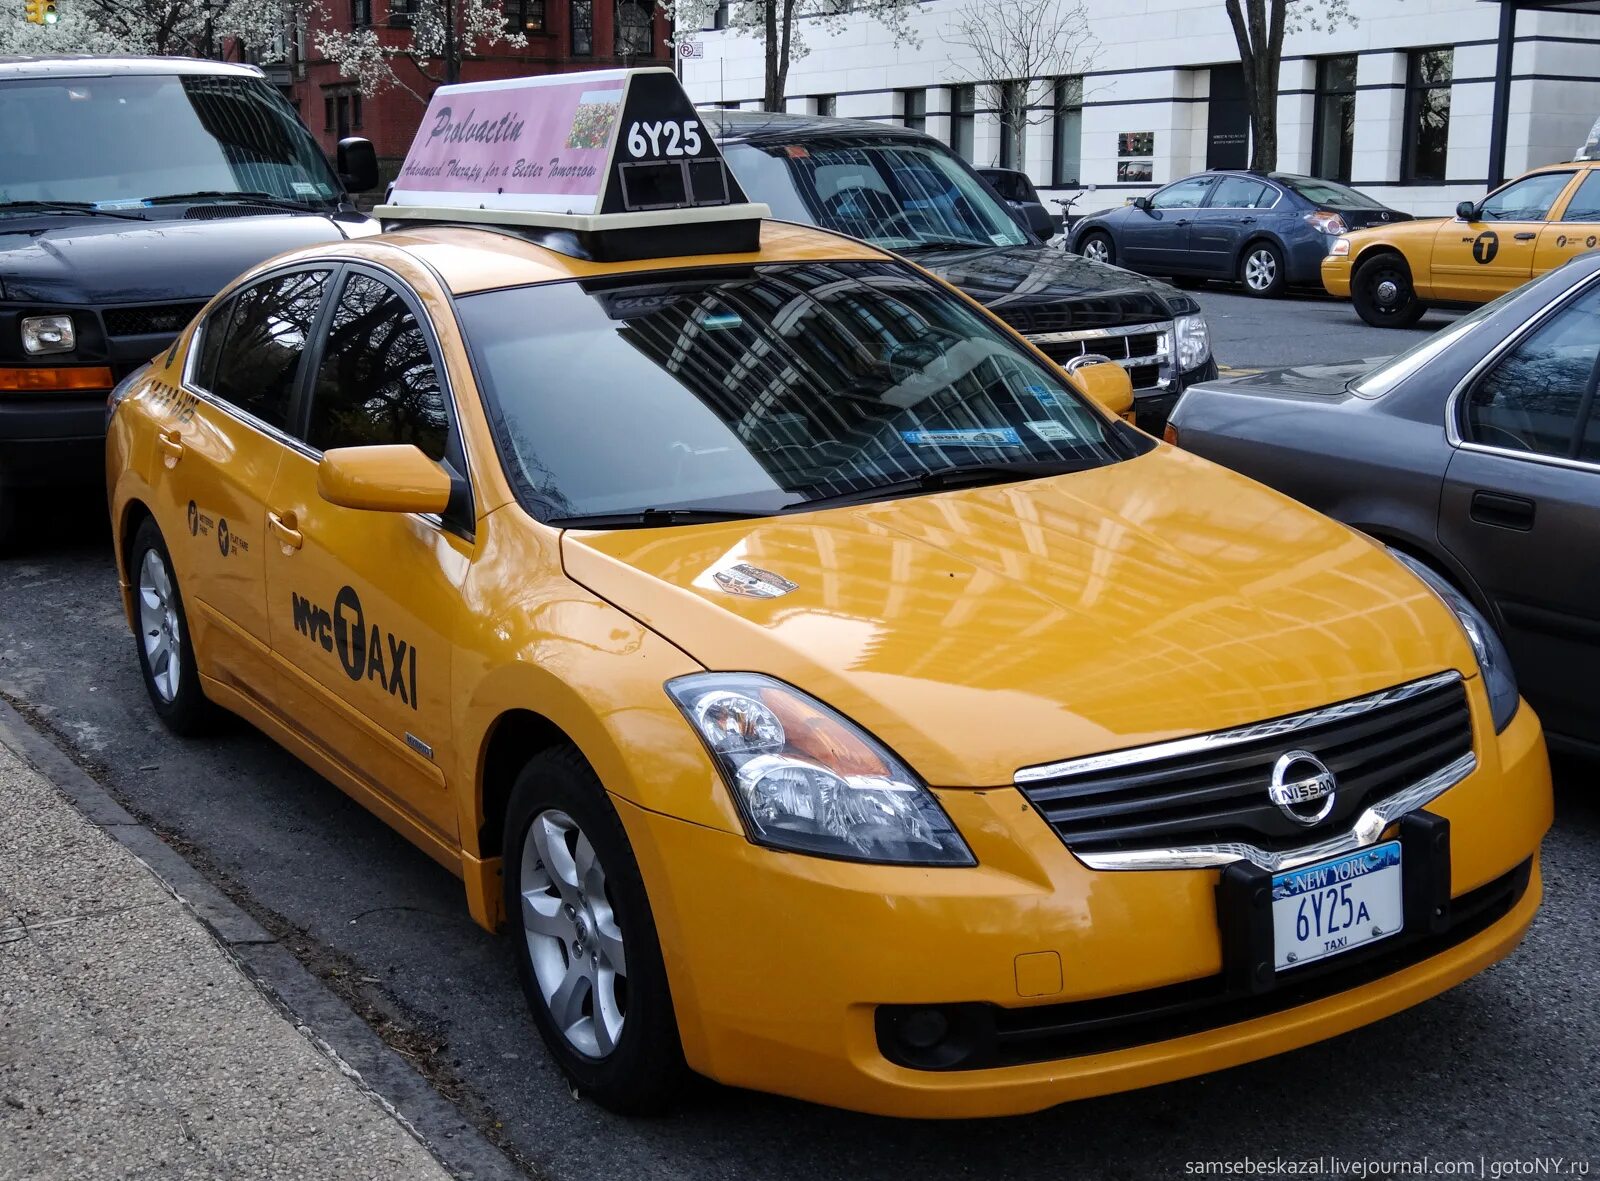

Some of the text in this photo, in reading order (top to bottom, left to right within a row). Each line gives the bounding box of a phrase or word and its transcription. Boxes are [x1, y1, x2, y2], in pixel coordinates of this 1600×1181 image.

[628, 121, 701, 158] 6Y25
[404, 157, 597, 183] Advanced Therapy for a Better Tomorrow
[292, 592, 417, 711] NYC TAXI
[1281, 778, 1335, 801] NISSAN
[1296, 856, 1369, 893] NEW YORK
[1324, 936, 1347, 951] TAXI
